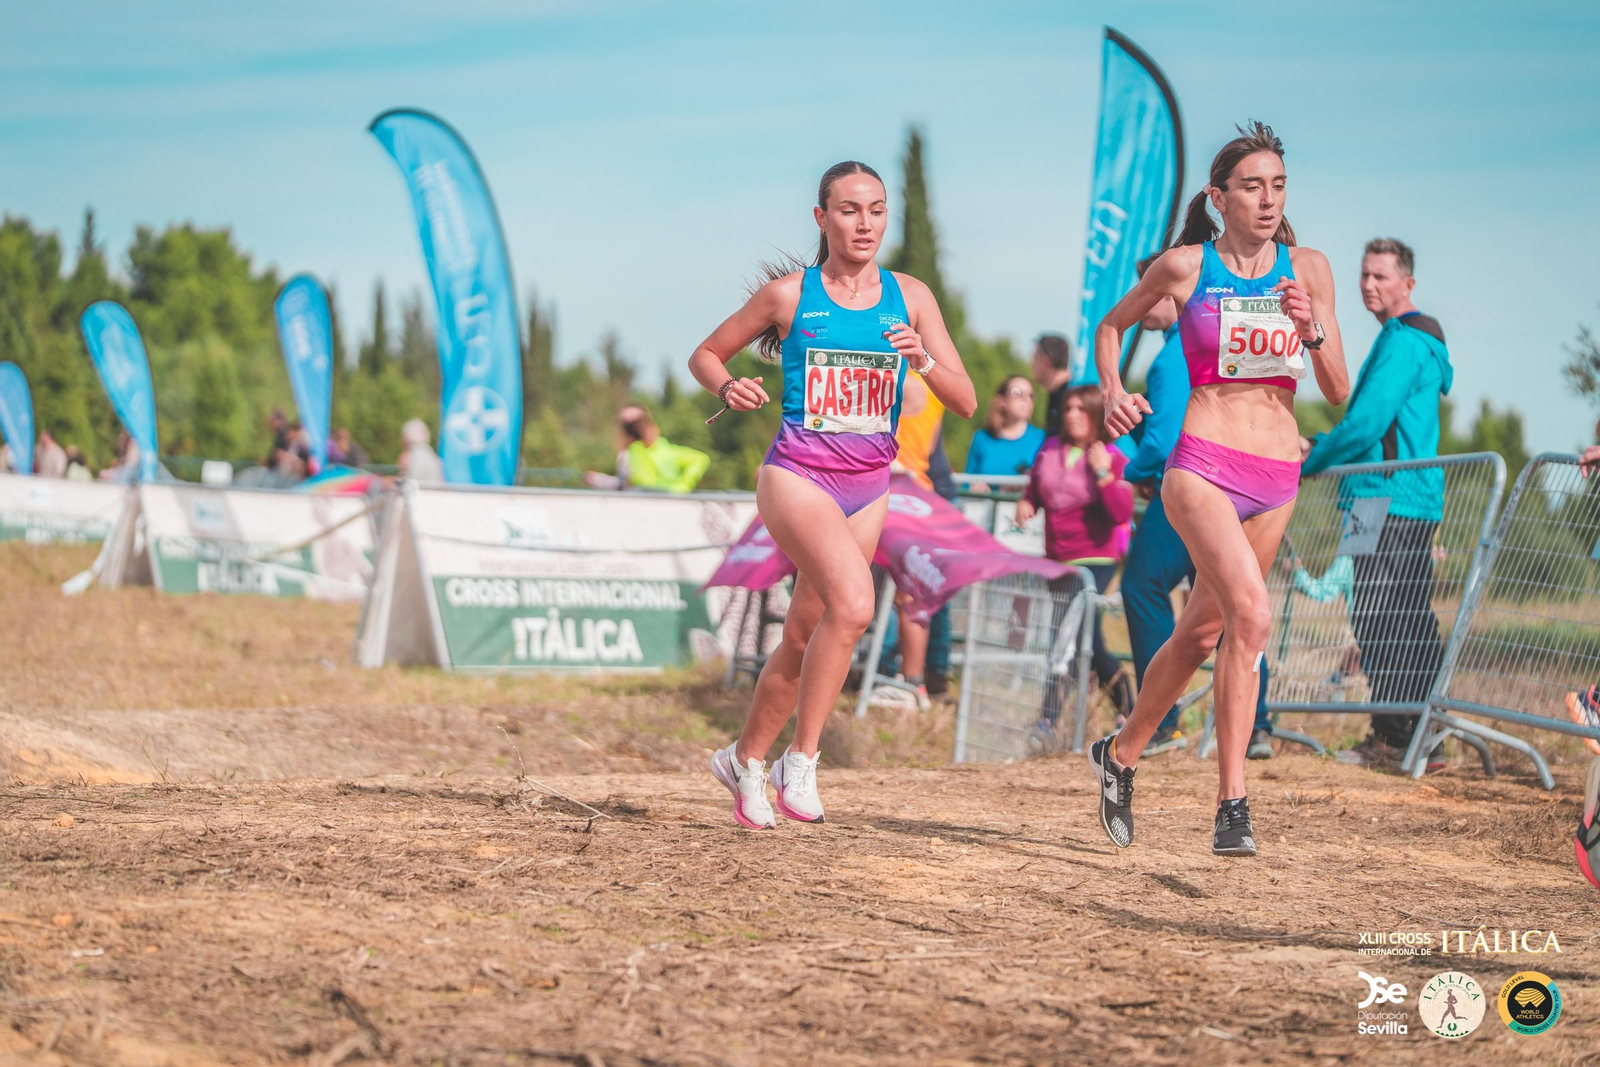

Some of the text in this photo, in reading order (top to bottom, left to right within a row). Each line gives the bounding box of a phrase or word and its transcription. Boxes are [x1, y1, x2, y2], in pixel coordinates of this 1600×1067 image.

[1248, 298, 1282, 312] ITÁLIC
[1228, 326, 1301, 358] 5000
[833, 353, 876, 367] ITÁLICA
[807, 366, 895, 417] CASTRO
[445, 577, 688, 609] CROSS INTERNACIONAL
[511, 607, 644, 662] ITÁLICA
